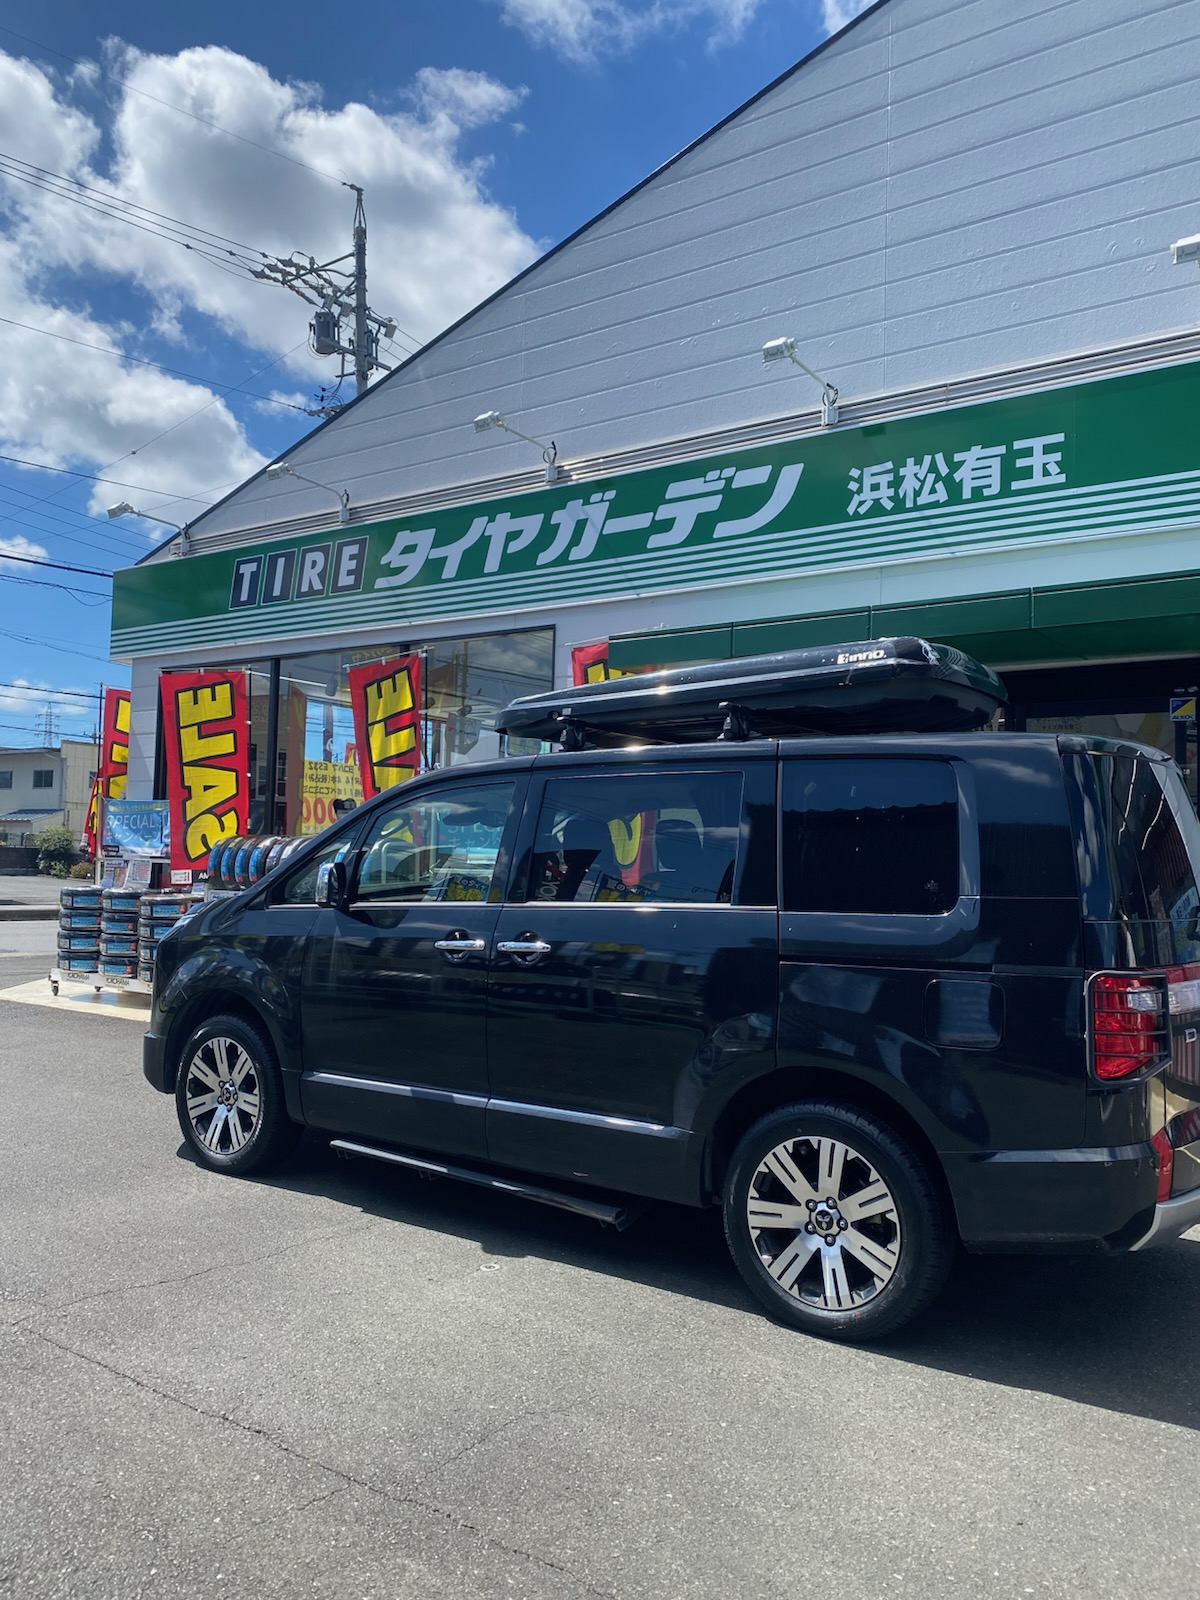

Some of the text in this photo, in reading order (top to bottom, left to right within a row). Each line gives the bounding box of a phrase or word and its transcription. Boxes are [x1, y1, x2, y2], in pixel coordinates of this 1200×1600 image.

[236, 433, 1066, 602] TIRE タイヤガーデン 浜松有玉
[105, 813, 156, 829] SPECIAL
